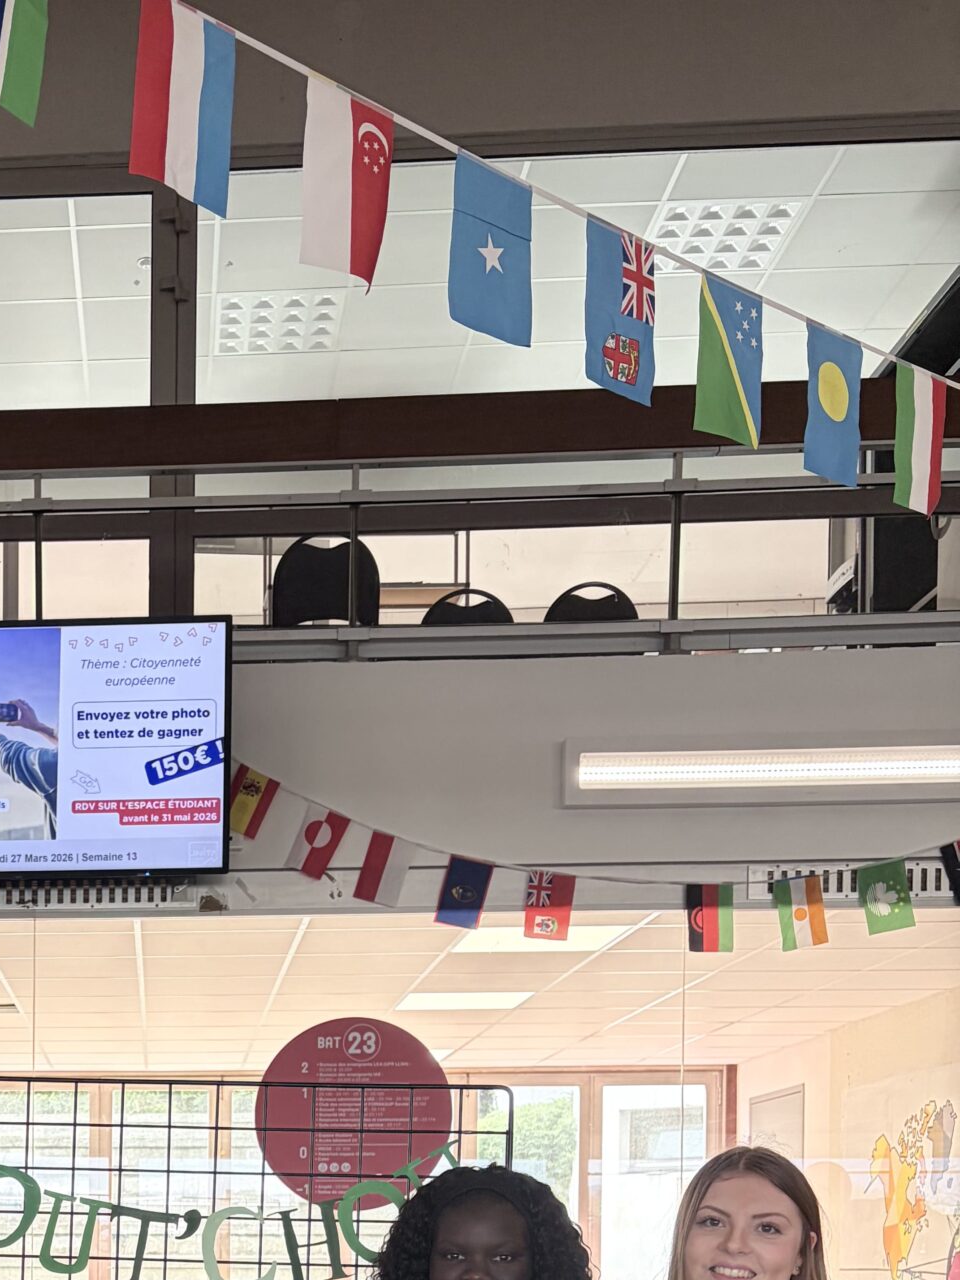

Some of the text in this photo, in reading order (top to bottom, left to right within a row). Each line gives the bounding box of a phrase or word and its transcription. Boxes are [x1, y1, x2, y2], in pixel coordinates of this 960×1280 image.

[81, 659, 120, 669] Thème
[130, 656, 201, 670] Citoyenneté
[105, 675, 176, 687] européenne
[77, 708, 210, 722] Envoyez votre photo
[77, 728, 203, 740] et tentez de gagner
[151, 745, 212, 779] 150€
[75, 799, 217, 811] RDV SUR L'ESPACE ÉTUDIANT
[122, 812, 217, 823] avant le 31 mai 2026
[11, 855, 22, 863] 27
[25, 854, 48, 863] Mars
[50, 854, 74, 862] 2026
[82, 852, 124, 862] Semaine
[126, 852, 138, 861] 13
[317, 1032, 376, 1054] BAT 23
[301, 1062, 309, 1073] 2
[301, 1088, 308, 1098] 1
[300, 1147, 308, 1158] 0
